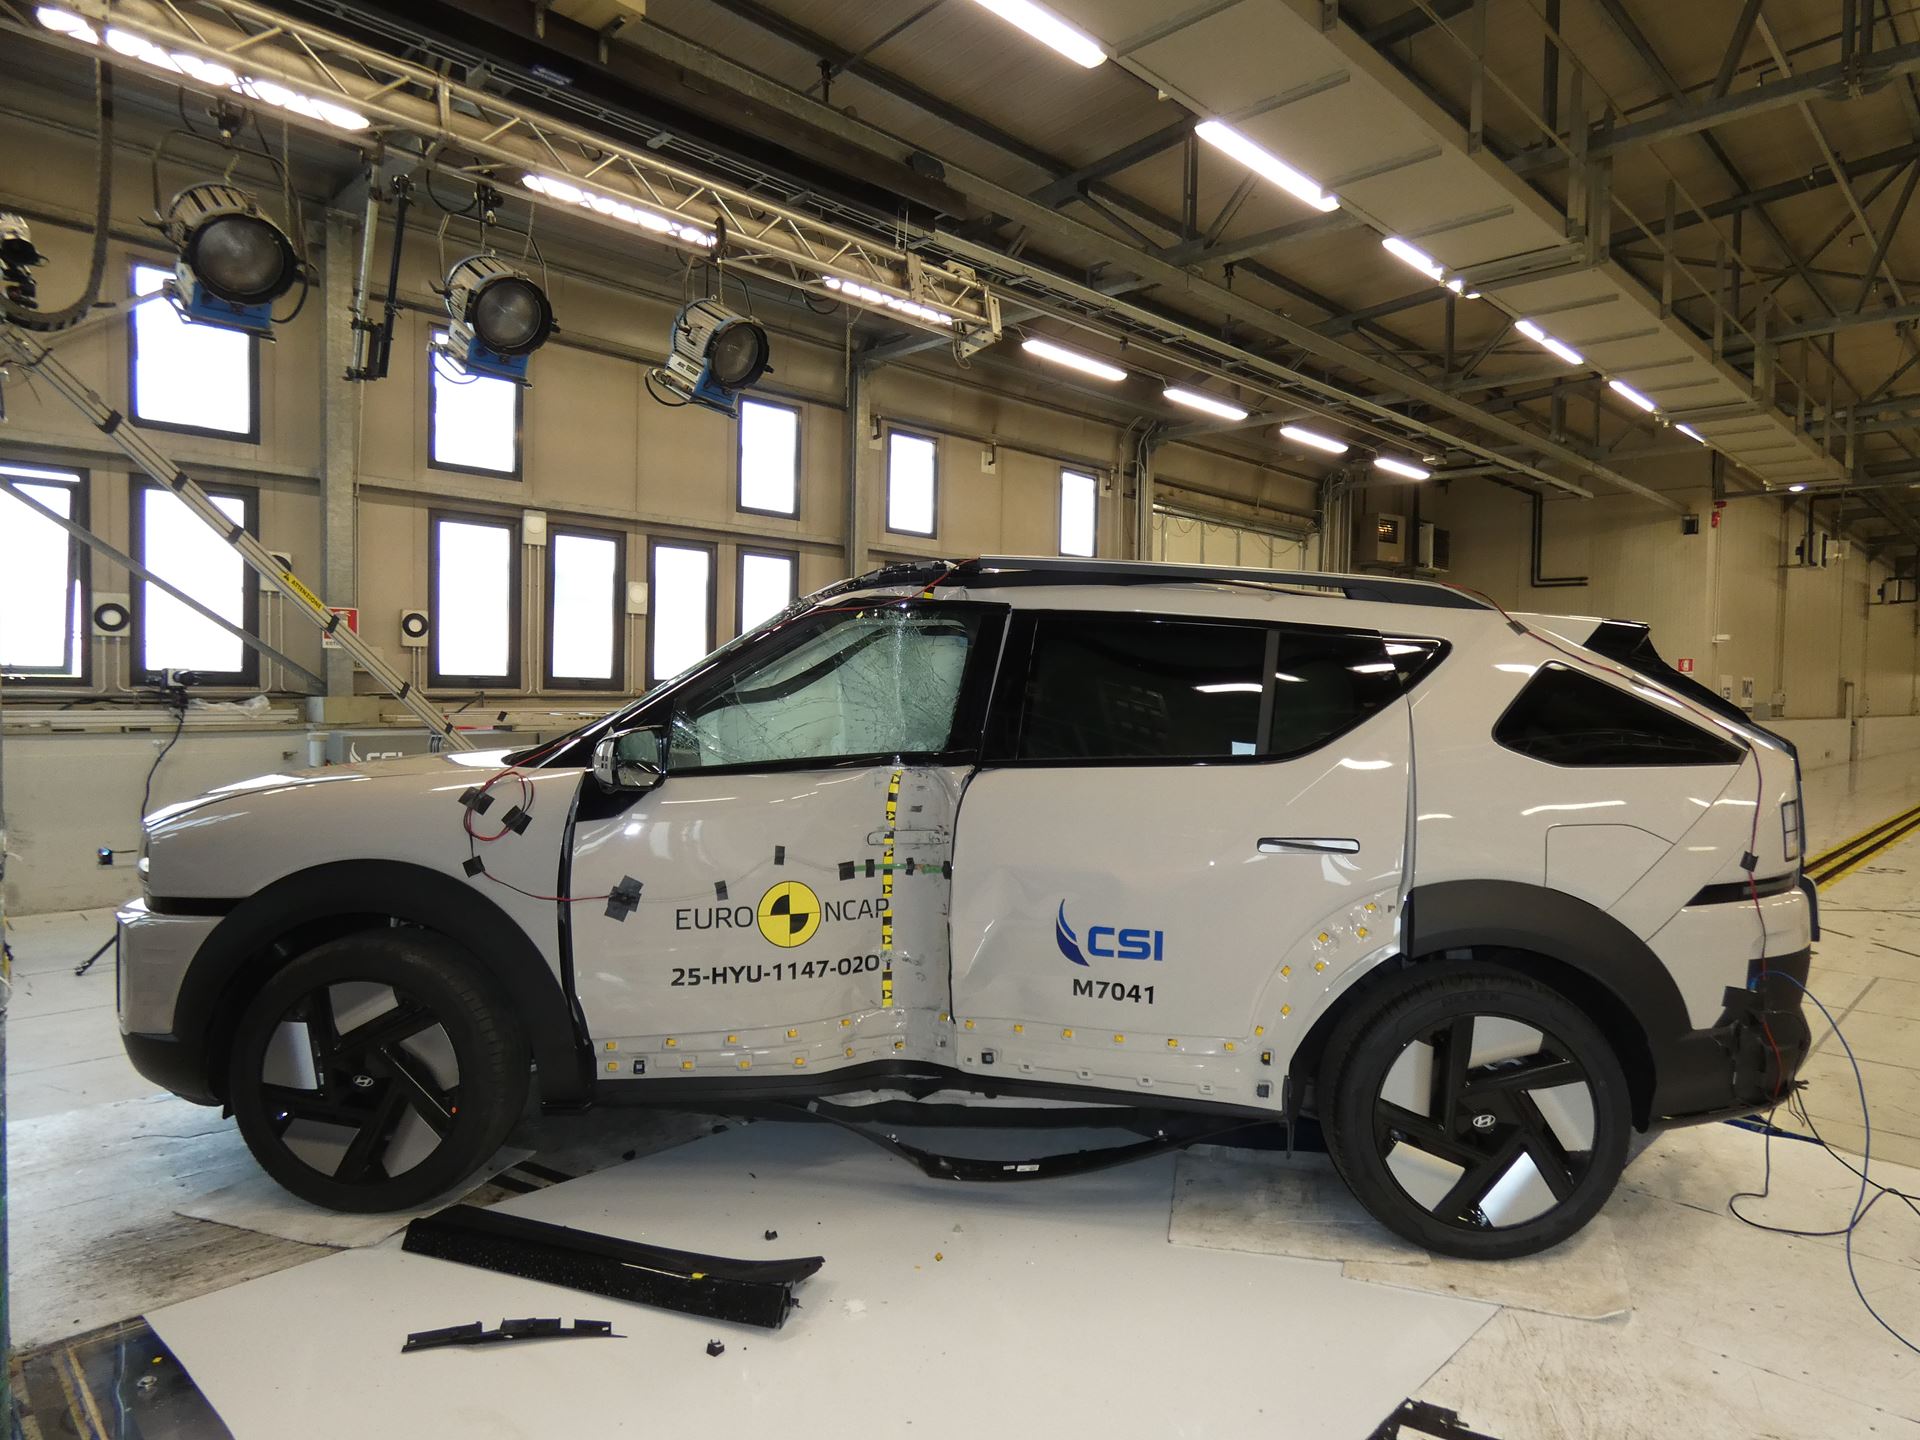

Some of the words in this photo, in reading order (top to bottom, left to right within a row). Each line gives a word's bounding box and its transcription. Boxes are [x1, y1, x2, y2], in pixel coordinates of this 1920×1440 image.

[291, 579, 322, 609] ATTENZIONE
[675, 906, 754, 930] EURO
[825, 898, 890, 922] NCAP
[1087, 926, 1163, 961] CSI
[671, 954, 880, 986] 25-HYU-1147-020
[1072, 978, 1154, 1005] M7041
